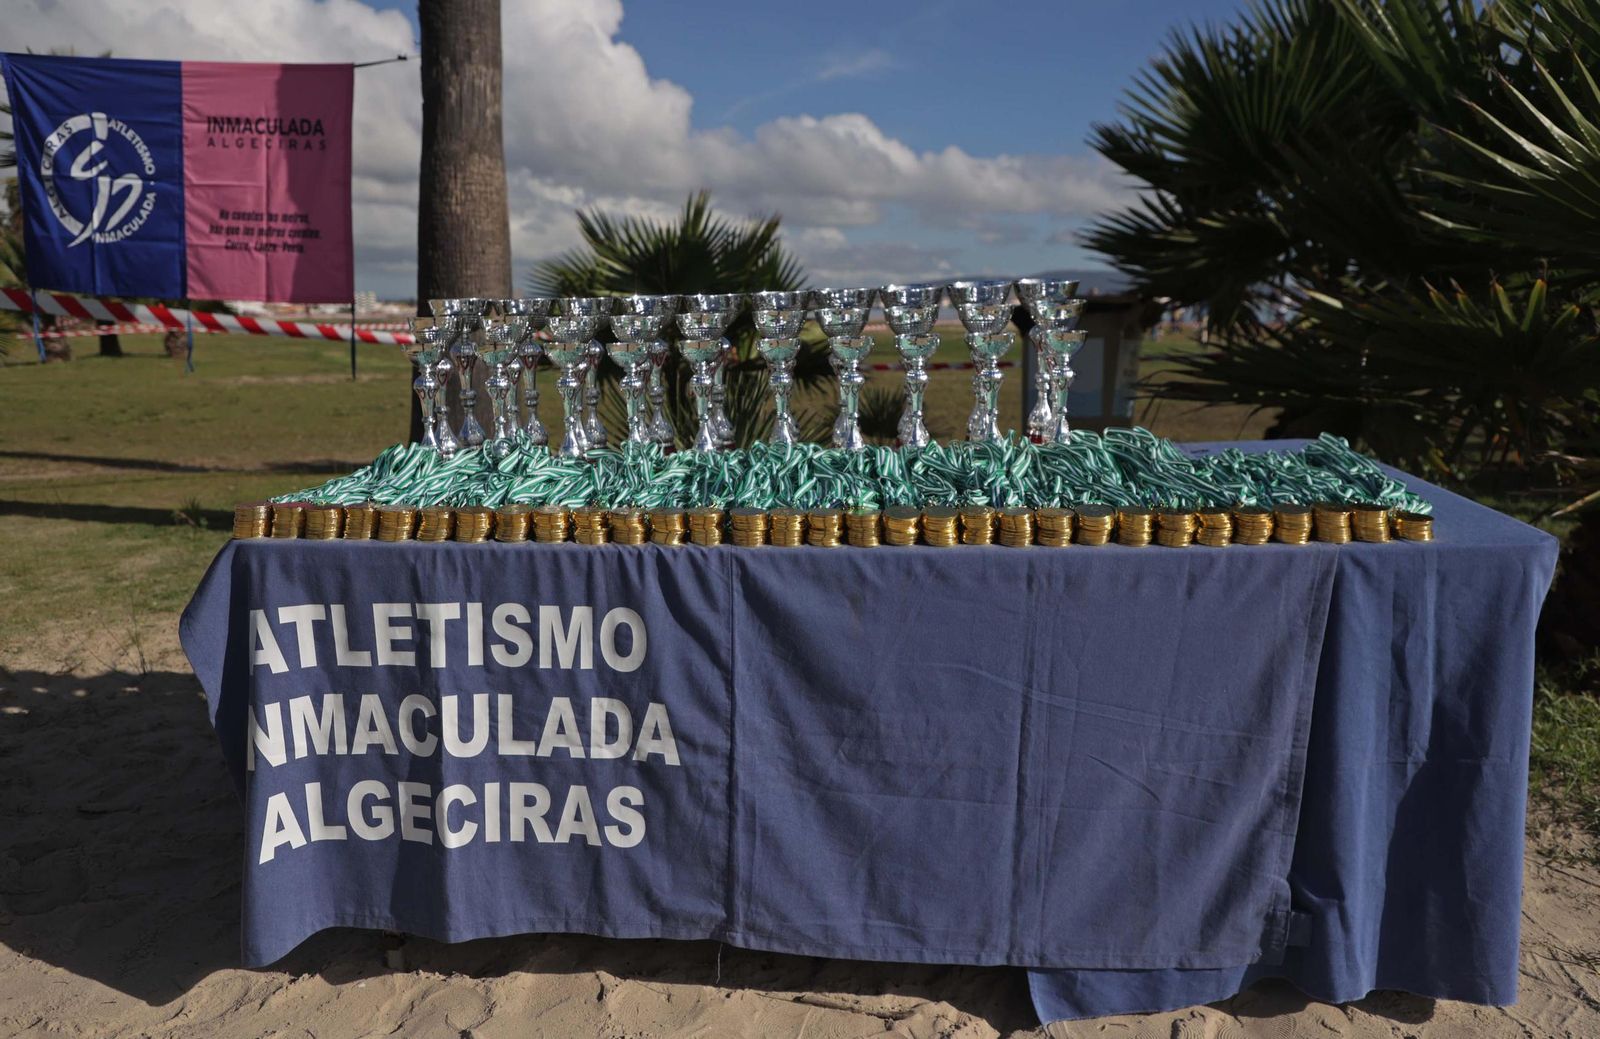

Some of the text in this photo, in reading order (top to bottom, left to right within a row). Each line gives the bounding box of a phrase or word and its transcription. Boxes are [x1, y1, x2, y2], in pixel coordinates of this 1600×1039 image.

[108, 119, 156, 175] ATLETISMO
[207, 116, 325, 136] INMACULADA
[207, 137, 326, 150] ALGECIRAS
[249, 602, 647, 675] ATLETISMO
[247, 693, 681, 771] NMACULADA
[259, 780, 647, 865] ALGECIRAS
